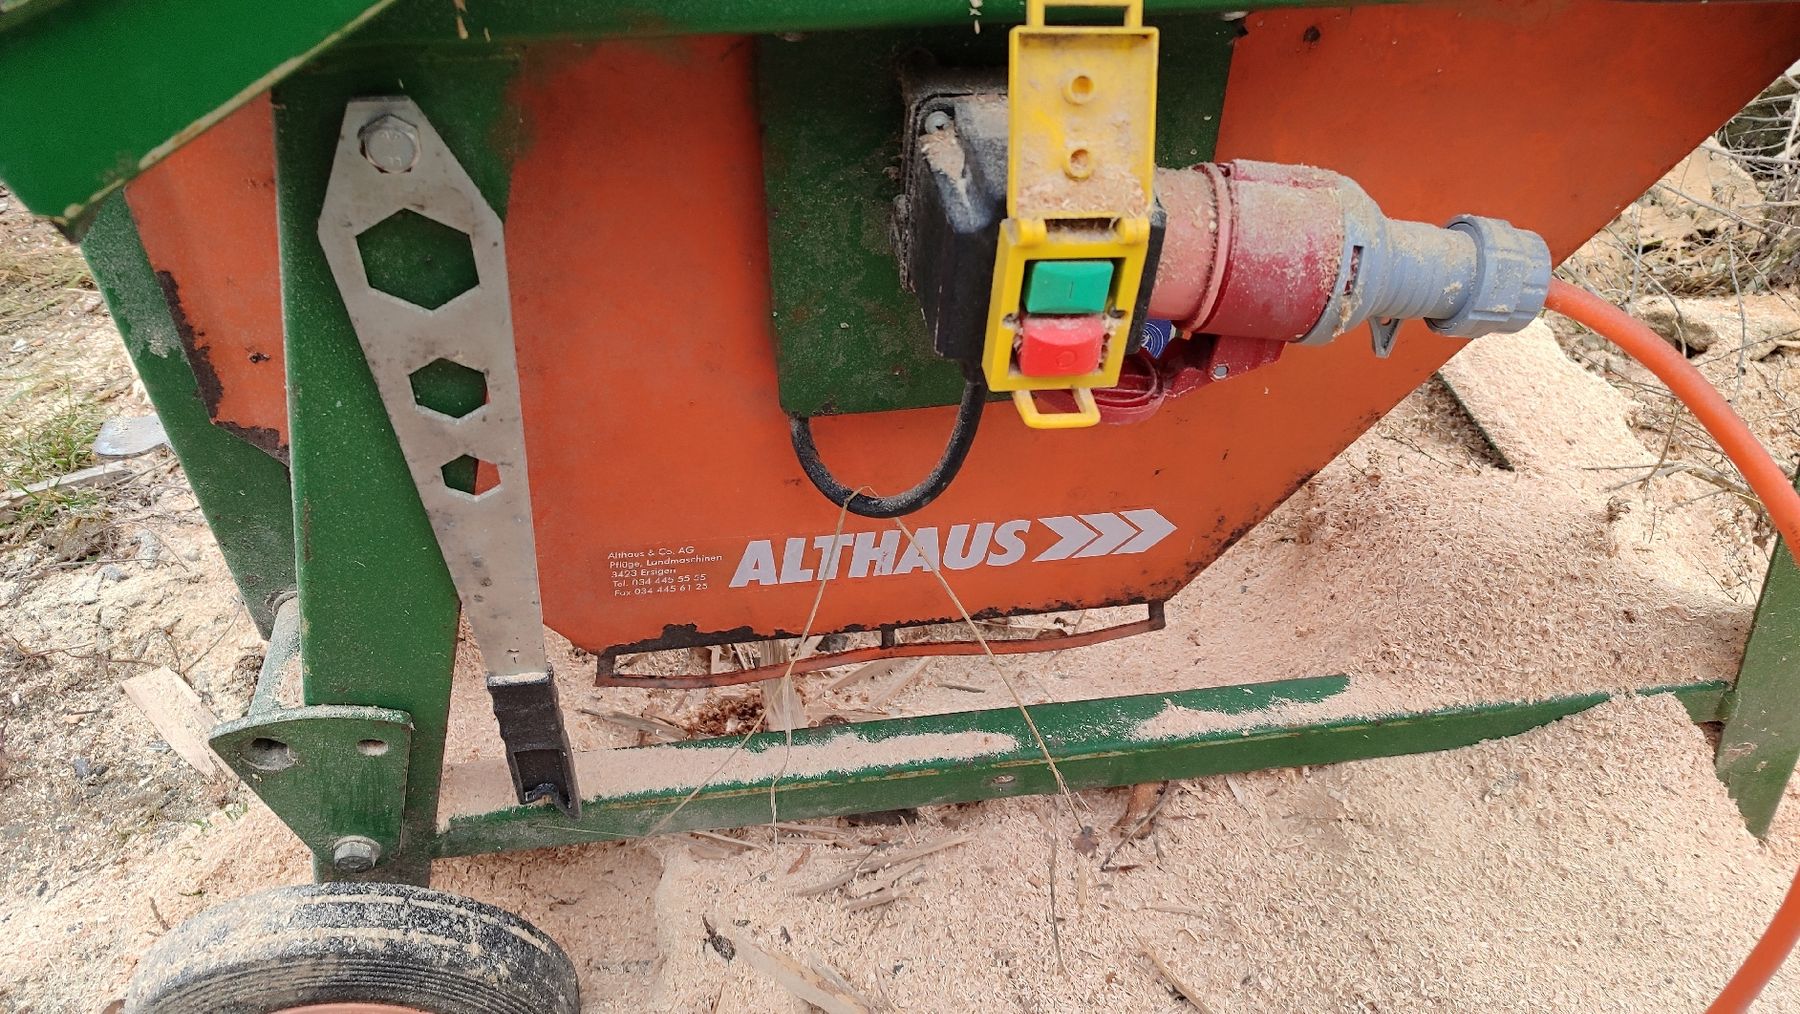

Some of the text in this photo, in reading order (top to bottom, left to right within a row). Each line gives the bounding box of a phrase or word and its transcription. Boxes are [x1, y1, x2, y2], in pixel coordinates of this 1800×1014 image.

[607, 551, 645, 560] Althaus
[658, 547, 675, 556] Co.
[729, 519, 1031, 588] ALTHAUS
[646, 554, 723, 567] Landmaschinen
[611, 569, 637, 578] 3423
[613, 579, 629, 588] Tel.
[631, 578, 651, 586] 034
[614, 589, 632, 597] Fax
[634, 587, 653, 595] 034
[657, 585, 677, 593] 445
